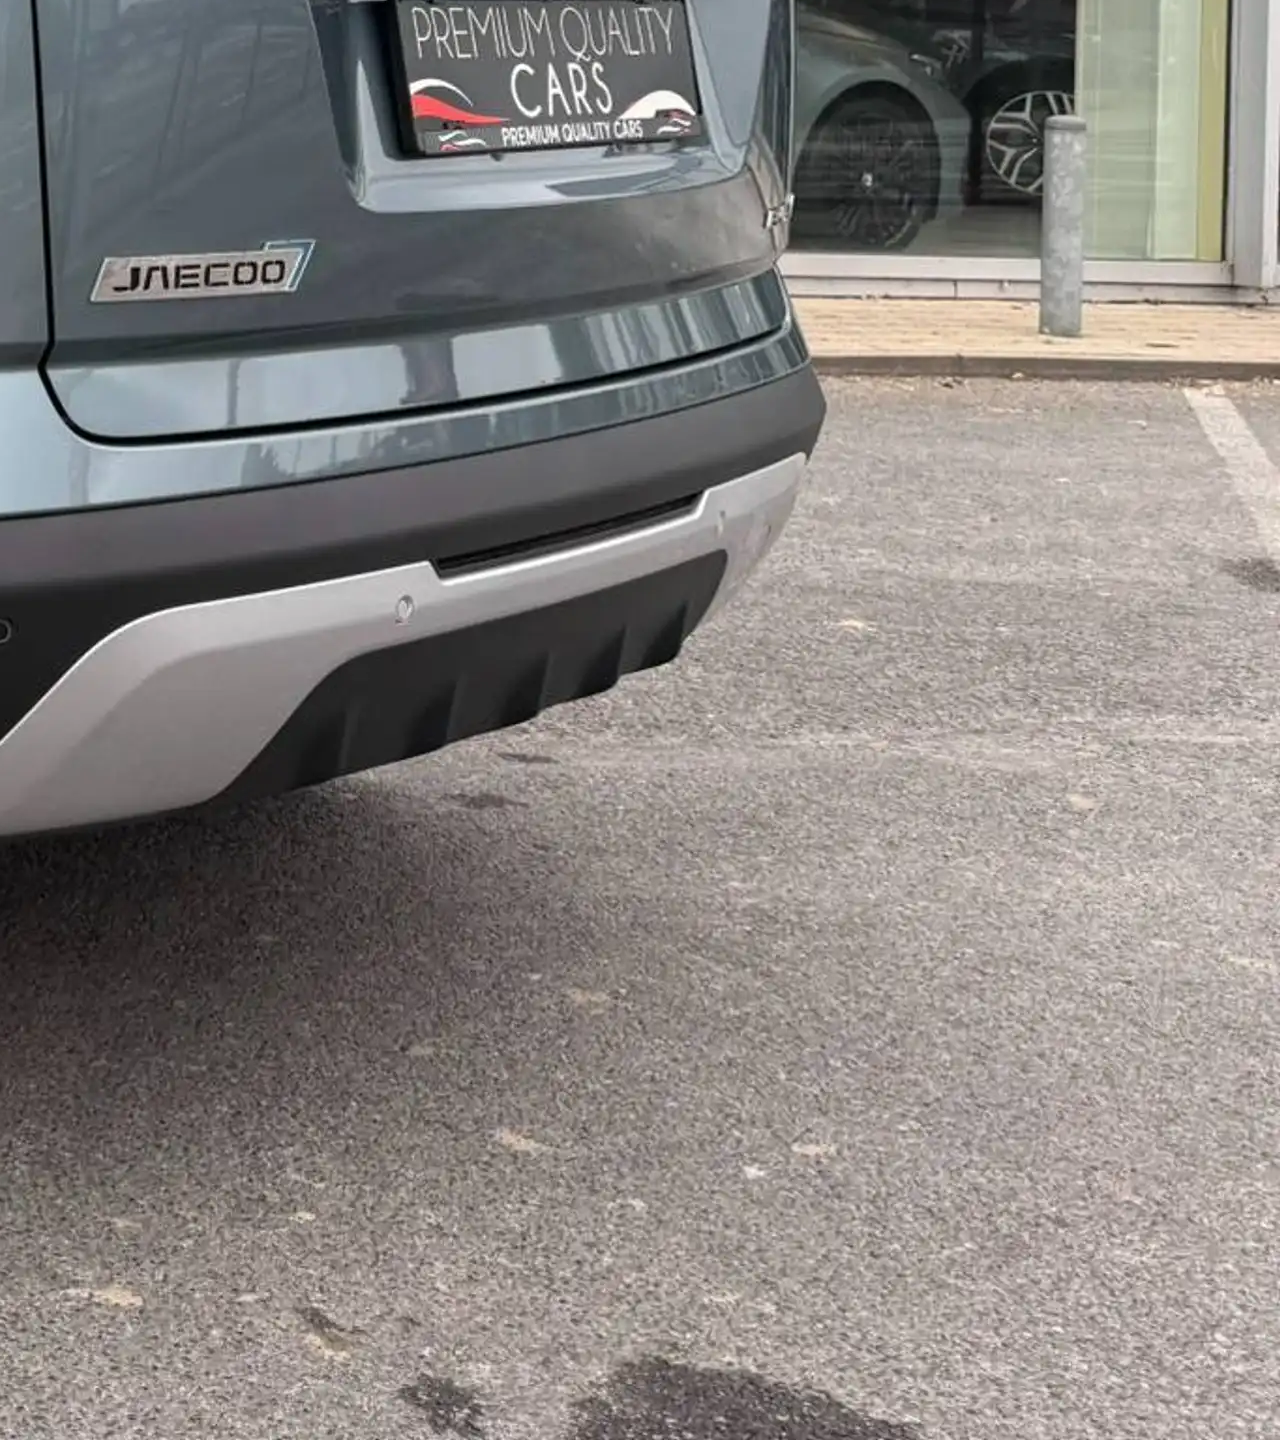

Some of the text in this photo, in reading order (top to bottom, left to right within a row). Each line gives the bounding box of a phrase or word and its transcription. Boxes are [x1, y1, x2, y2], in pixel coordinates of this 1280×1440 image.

[411, 6, 675, 61] PREMIUM QUALITY
[510, 62, 614, 118] CARS
[502, 118, 644, 148] PREMIUM QUALITY CARS
[112, 259, 286, 293] JAECOO
